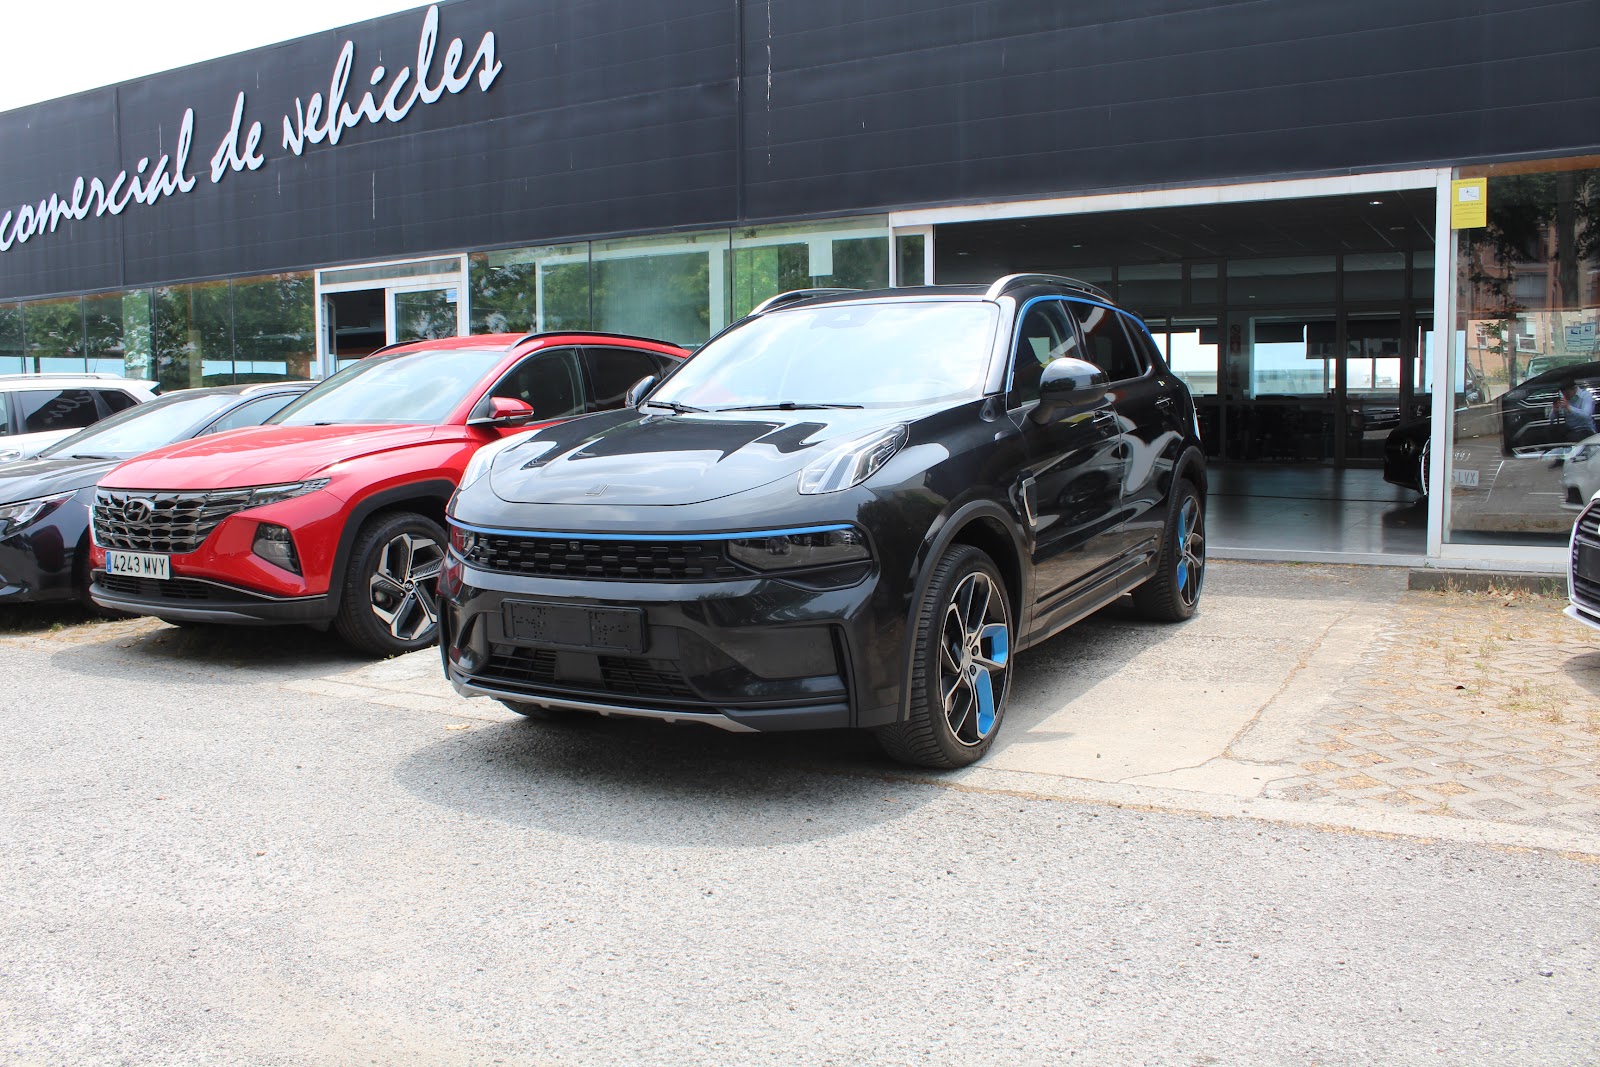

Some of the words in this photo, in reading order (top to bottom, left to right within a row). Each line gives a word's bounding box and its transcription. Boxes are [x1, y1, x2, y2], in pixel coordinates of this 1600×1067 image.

[0, 108, 196, 252] comercial
[211, 92, 264, 184] de
[283, 4, 503, 156] vehicles
[113, 554, 141, 574] 4243
[143, 556, 166, 576] MVY
